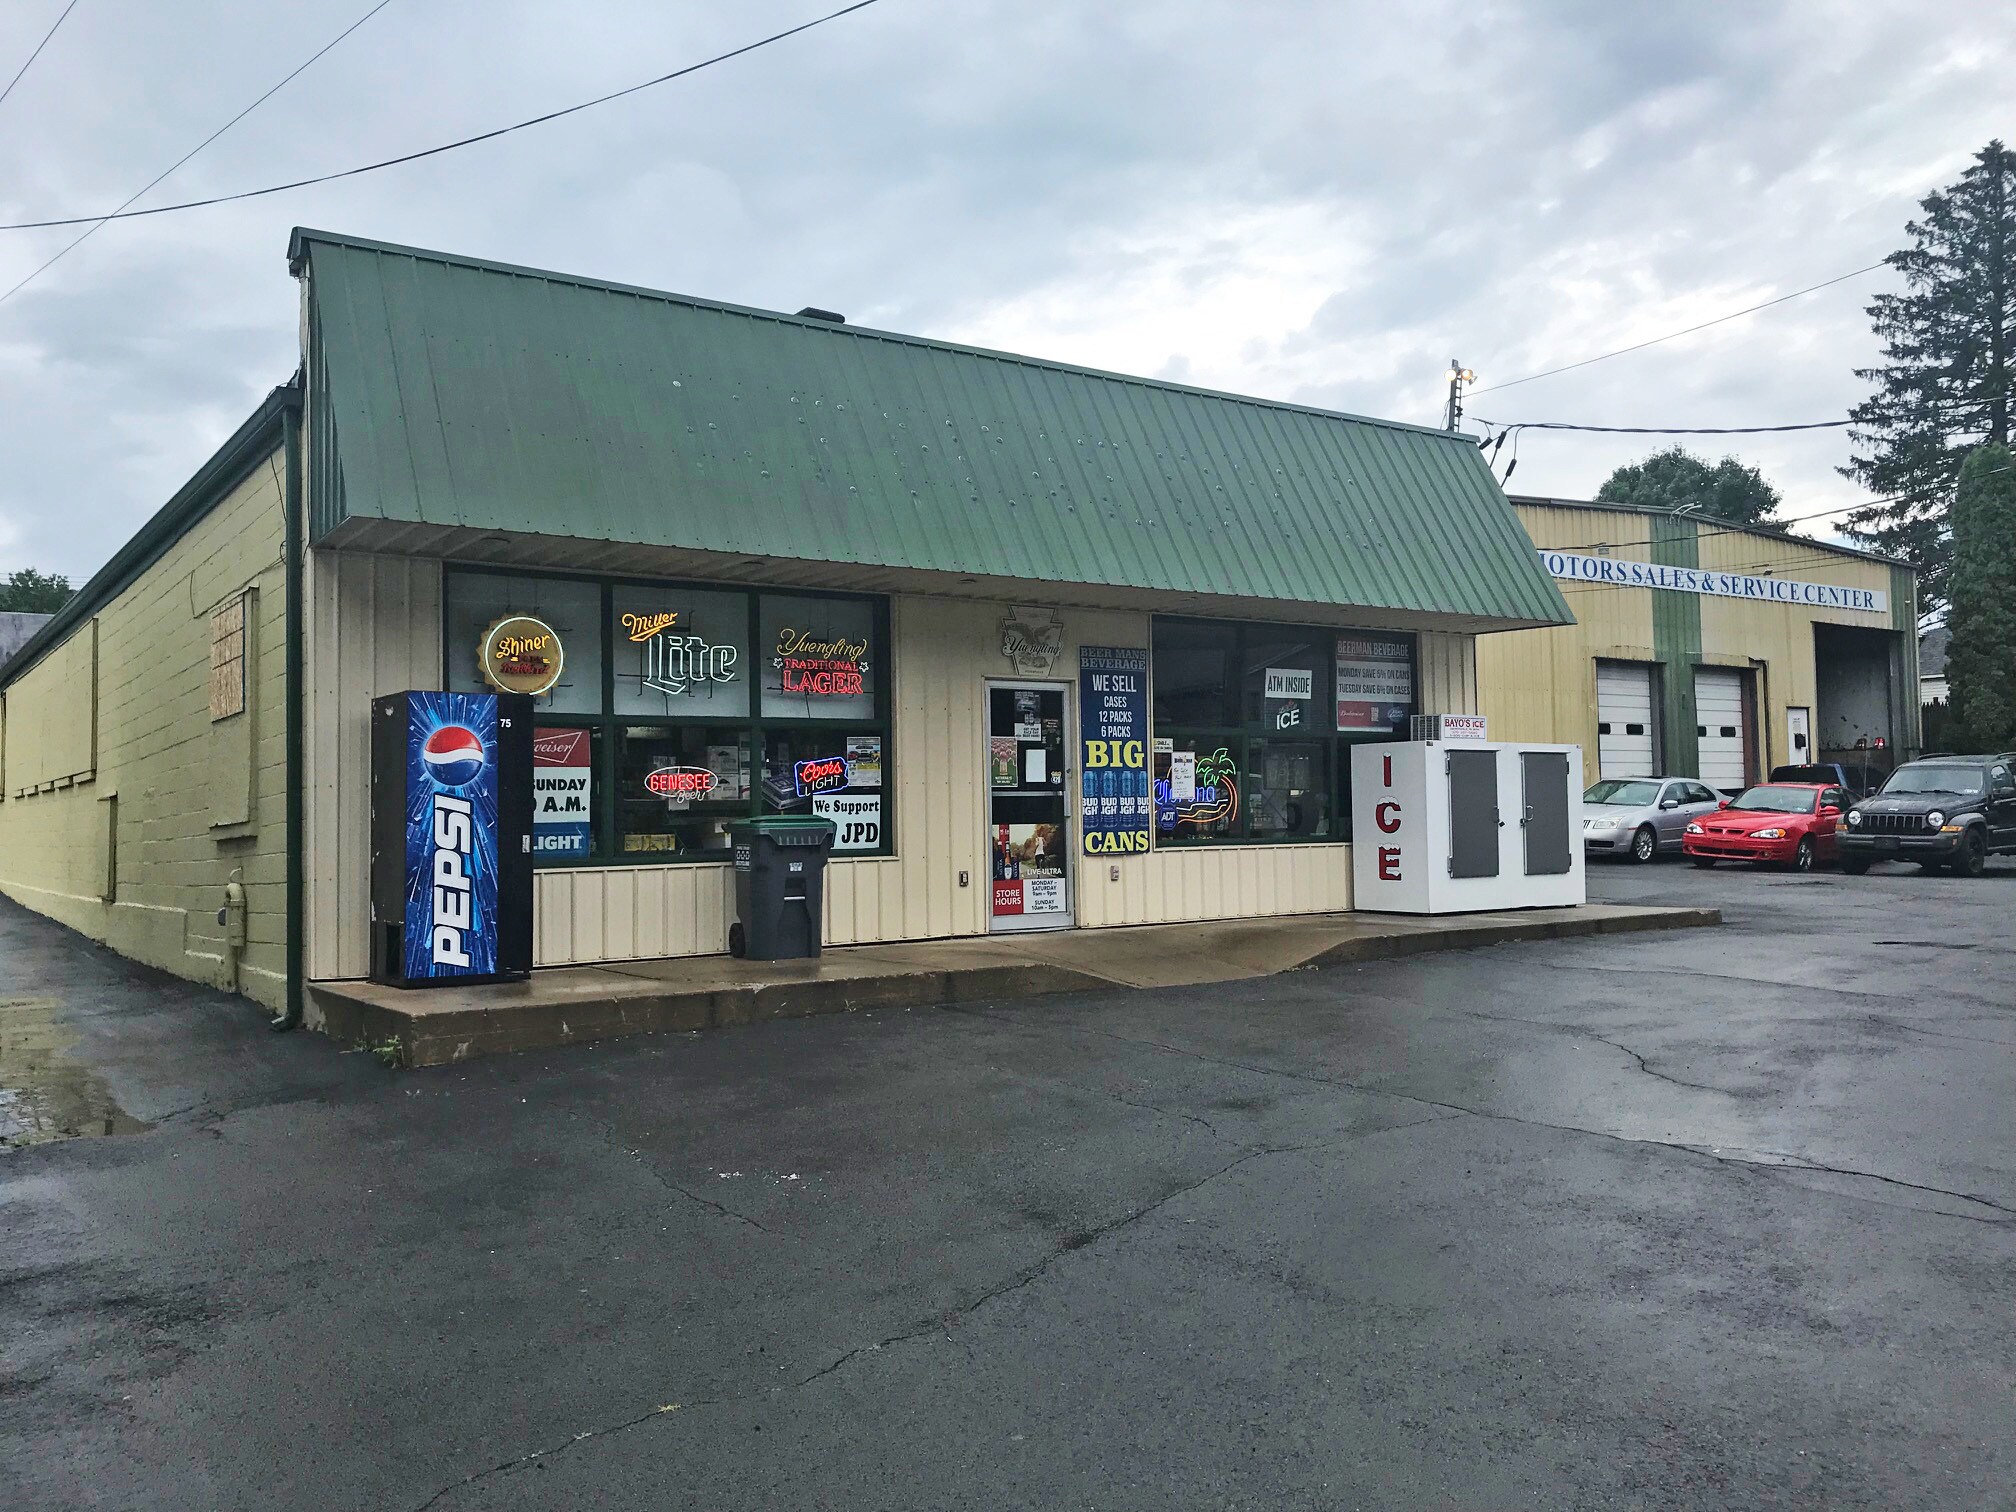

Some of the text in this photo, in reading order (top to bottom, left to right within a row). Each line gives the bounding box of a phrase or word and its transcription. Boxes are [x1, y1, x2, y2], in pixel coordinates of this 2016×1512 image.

[1632, 564, 1697, 589] SALES
[1701, 572, 1715, 592] &
[1720, 574, 1799, 601] SERVICE
[1804, 584, 1874, 608] CENTER
[622, 612, 678, 634] Miller
[496, 633, 551, 658] Shiner
[777, 628, 867, 661] Yuengling
[1337, 640, 1409, 657] BEERMAN BEVERAGE
[1081, 647, 1146, 660] BEER MANS
[643, 633, 737, 694] Lite
[784, 658, 858, 672] TRADITIONAL
[1081, 658, 1146, 669] BEVERAGE
[1338, 667, 1361, 679] MONDAY
[1362, 669, 1376, 679] SAVE
[783, 670, 863, 694] LAGER
[1092, 674, 1137, 692] WE SELL
[1267, 675, 1310, 693] ATM INSIDE
[1339, 684, 1361, 694] TUESDAY
[1362, 684, 1376, 694] SAVE
[1394, 686, 1410, 695] CASES
[1104, 696, 1127, 707] CASES
[500, 719, 511, 728] 75
[1099, 711, 1132, 722] 12 PACKS
[1277, 709, 1299, 729] ICE
[1445, 719, 1471, 727] BAYO'S
[1101, 726, 1131, 737] 6 PACKS
[1085, 740, 1145, 768] BIG
[800, 760, 842, 782] Coors
[534, 779, 586, 791] UNDAY
[650, 773, 711, 791] GENESEE
[805, 775, 840, 796] LIGHT
[543, 797, 586, 812] A.M.
[676, 790, 706, 804] Beer
[1101, 797, 1117, 806] BUD
[1120, 797, 1135, 806] BUD
[815, 799, 879, 815] We Support
[1161, 812, 1175, 821] ADT
[1375, 751, 1401, 881] ICE
[841, 822, 879, 843] JPD
[534, 836, 582, 850] IGHT
[1085, 830, 1149, 853] CANS
[433, 794, 471, 967] PEPSI
[996, 889, 1020, 897] STORE
[995, 897, 1021, 905] HOURS
